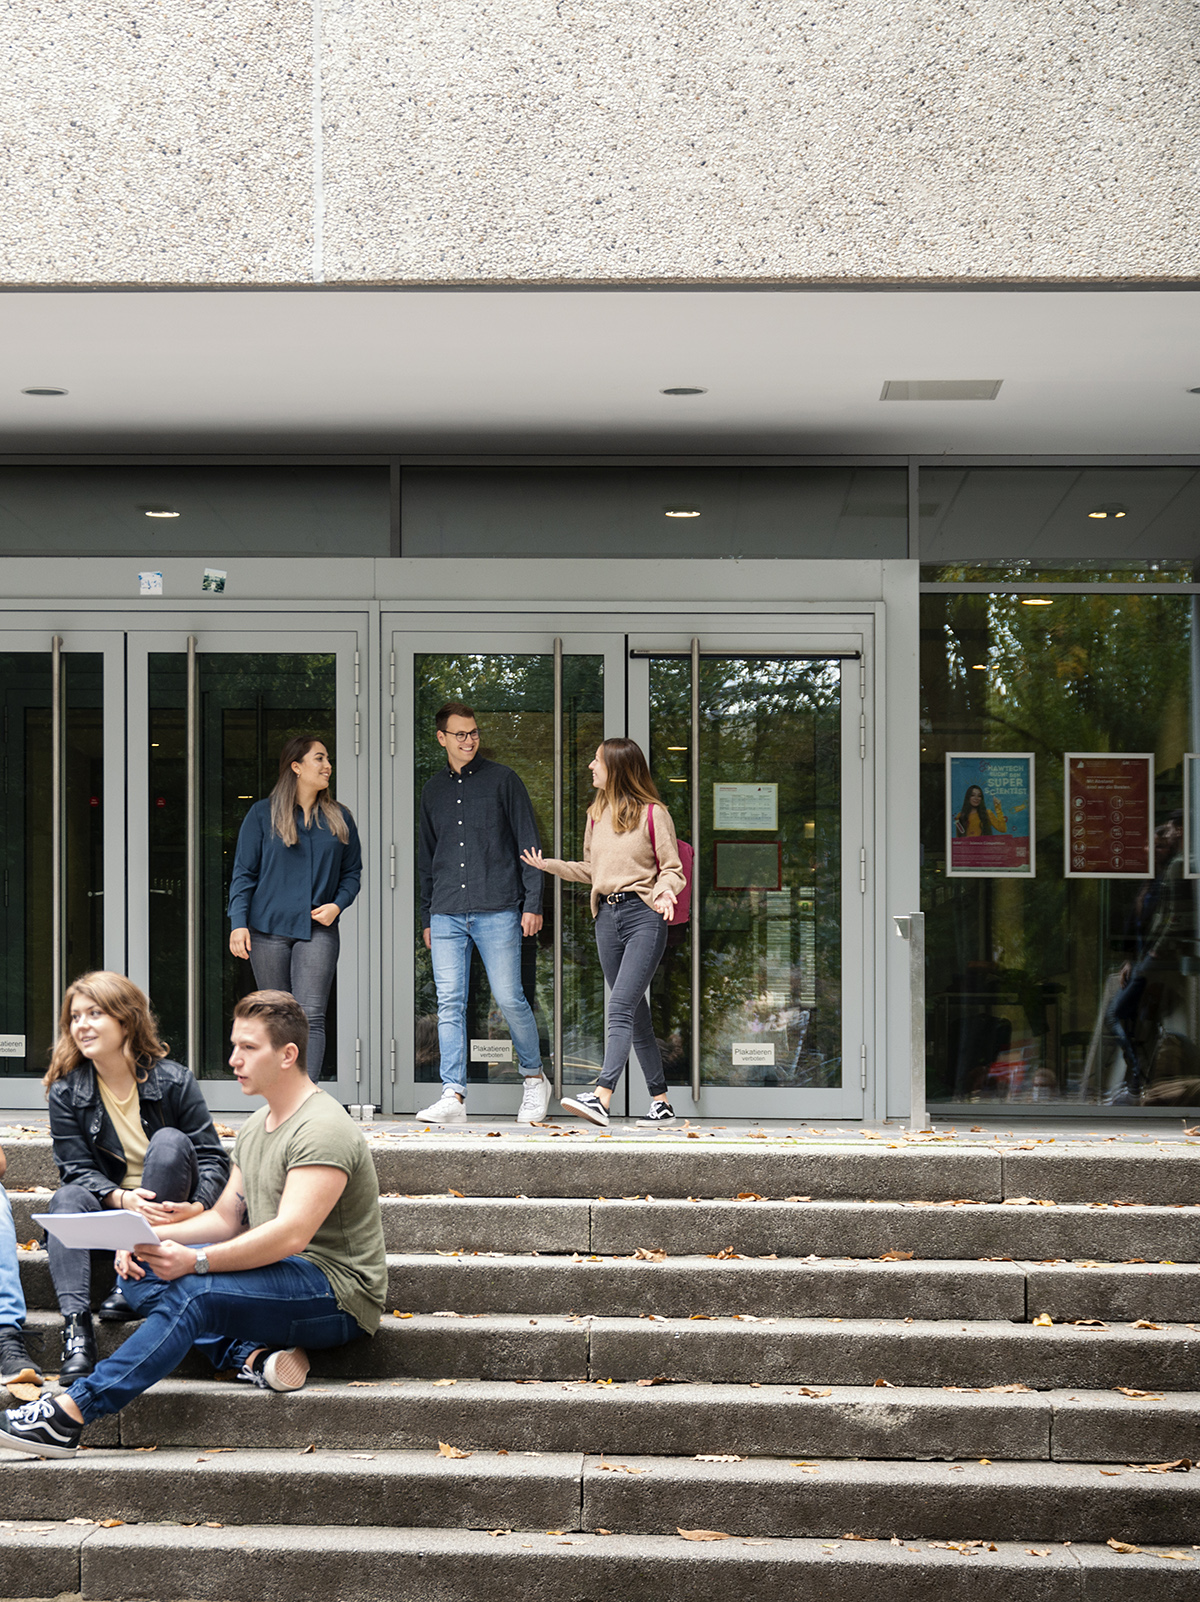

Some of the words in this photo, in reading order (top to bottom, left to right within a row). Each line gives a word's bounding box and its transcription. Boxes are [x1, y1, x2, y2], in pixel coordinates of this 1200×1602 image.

[987, 778, 1023, 787] SUPER
[984, 787, 1027, 796] SCIENTIST
[734, 1048, 773, 1056] Plakatieren
